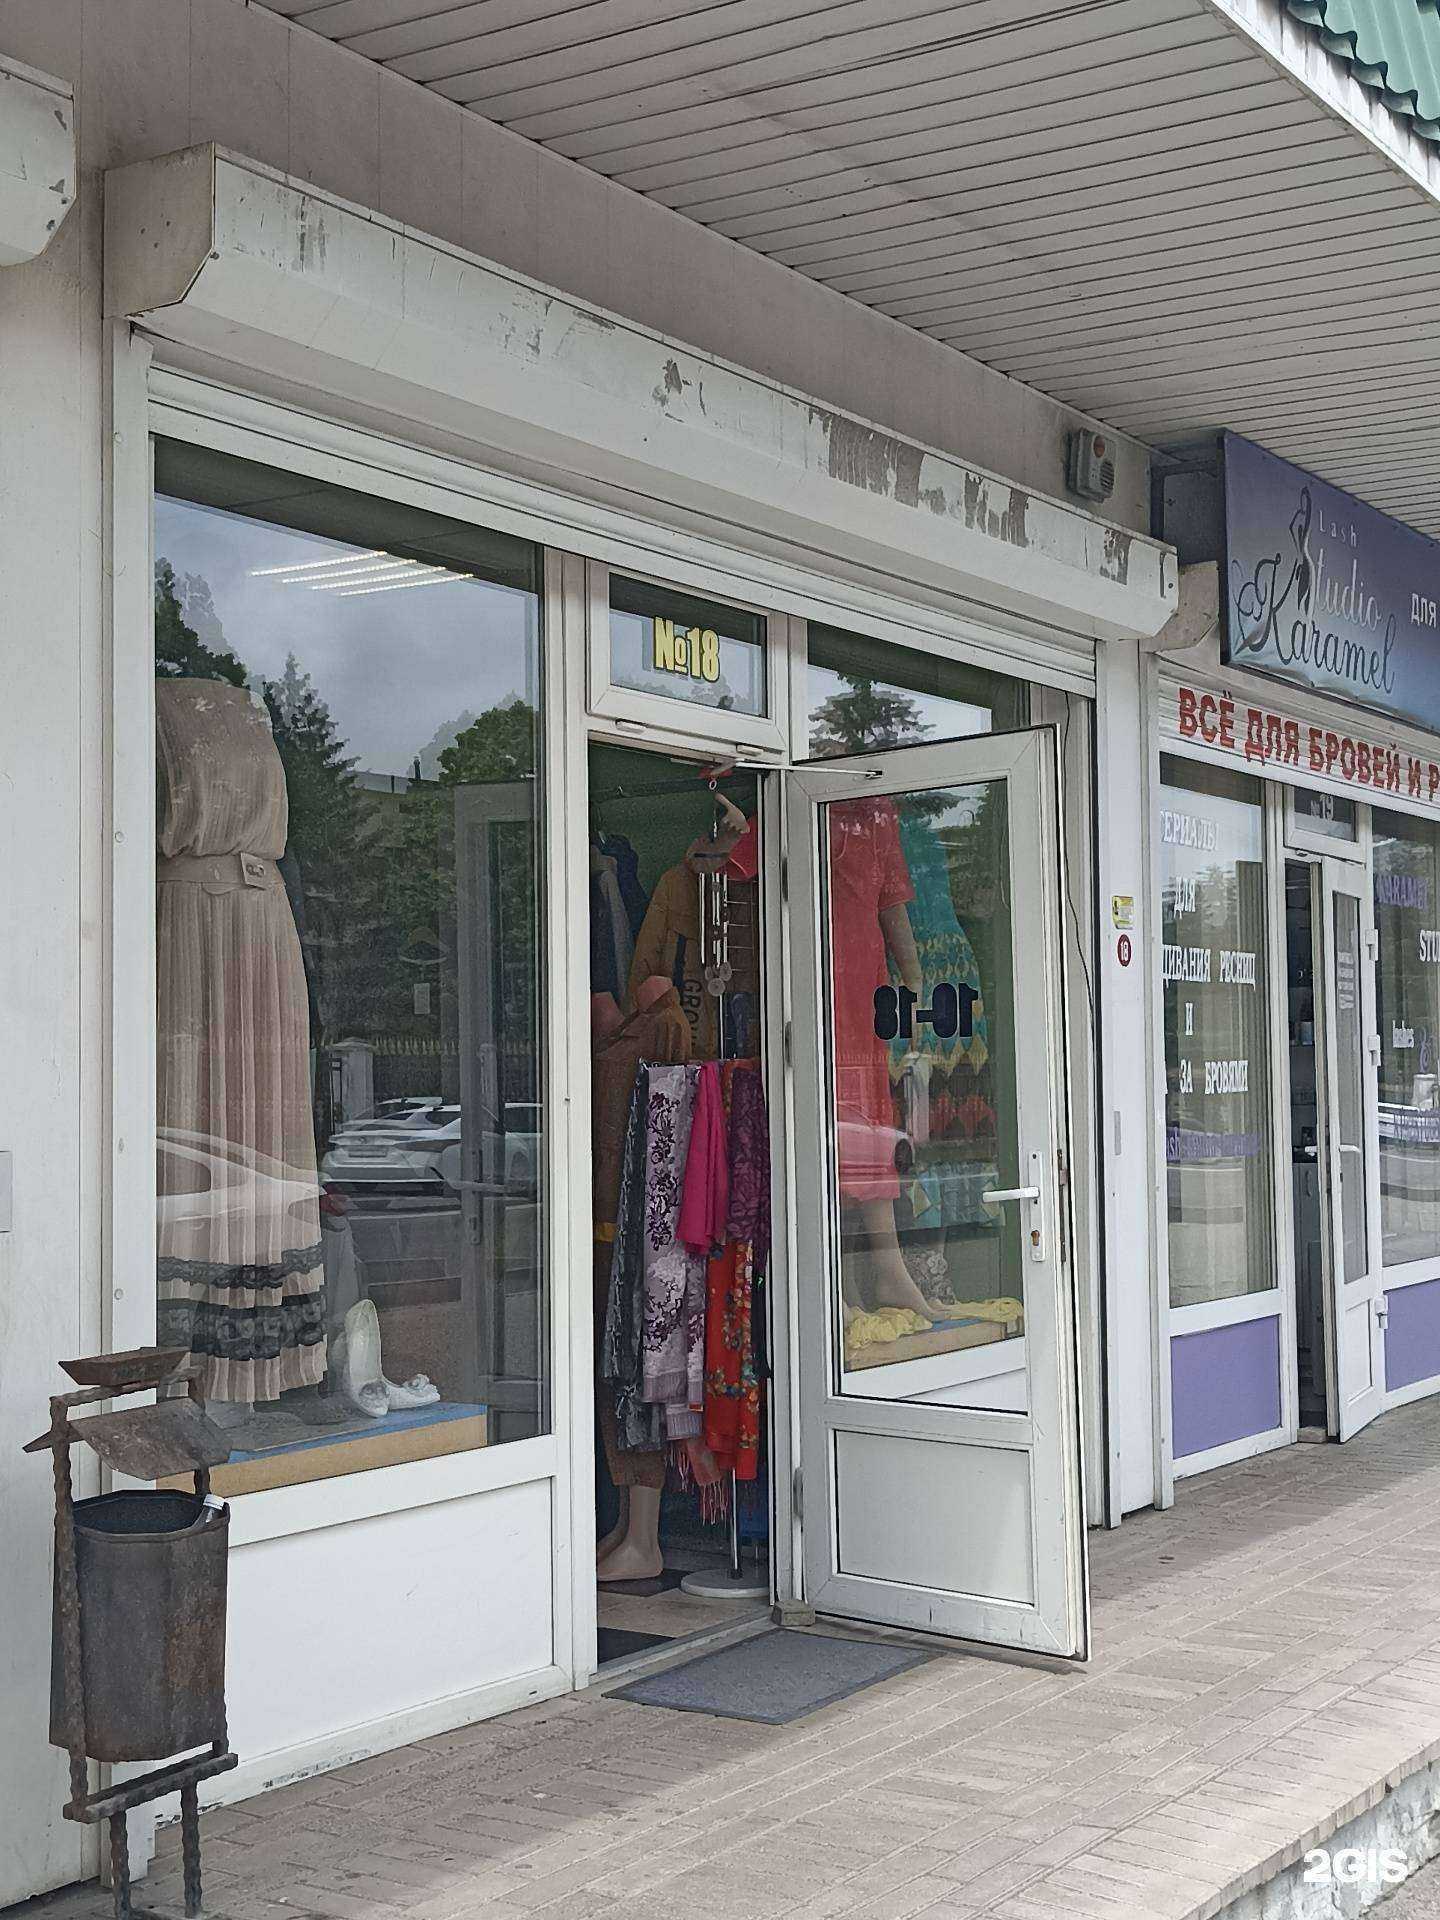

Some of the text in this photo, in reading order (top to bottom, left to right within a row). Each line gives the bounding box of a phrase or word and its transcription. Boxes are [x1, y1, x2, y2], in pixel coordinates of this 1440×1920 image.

[1318, 509, 1359, 548] Lash
[1236, 553, 1397, 694] Karamel
[1179, 687, 1236, 749] ВСЁ
[1244, 708, 1299, 767] ДЛЯ
[1308, 726, 1400, 793] БРОВЕЙ
[1407, 757, 1421, 799] И
[1173, 876, 1196, 920] ДЛЯ
[1219, 950, 1256, 991] РЕСНИЦ
[1185, 1002, 1193, 1036] И
[1179, 1059, 1249, 1095] ЗА БРОВЯМИ
